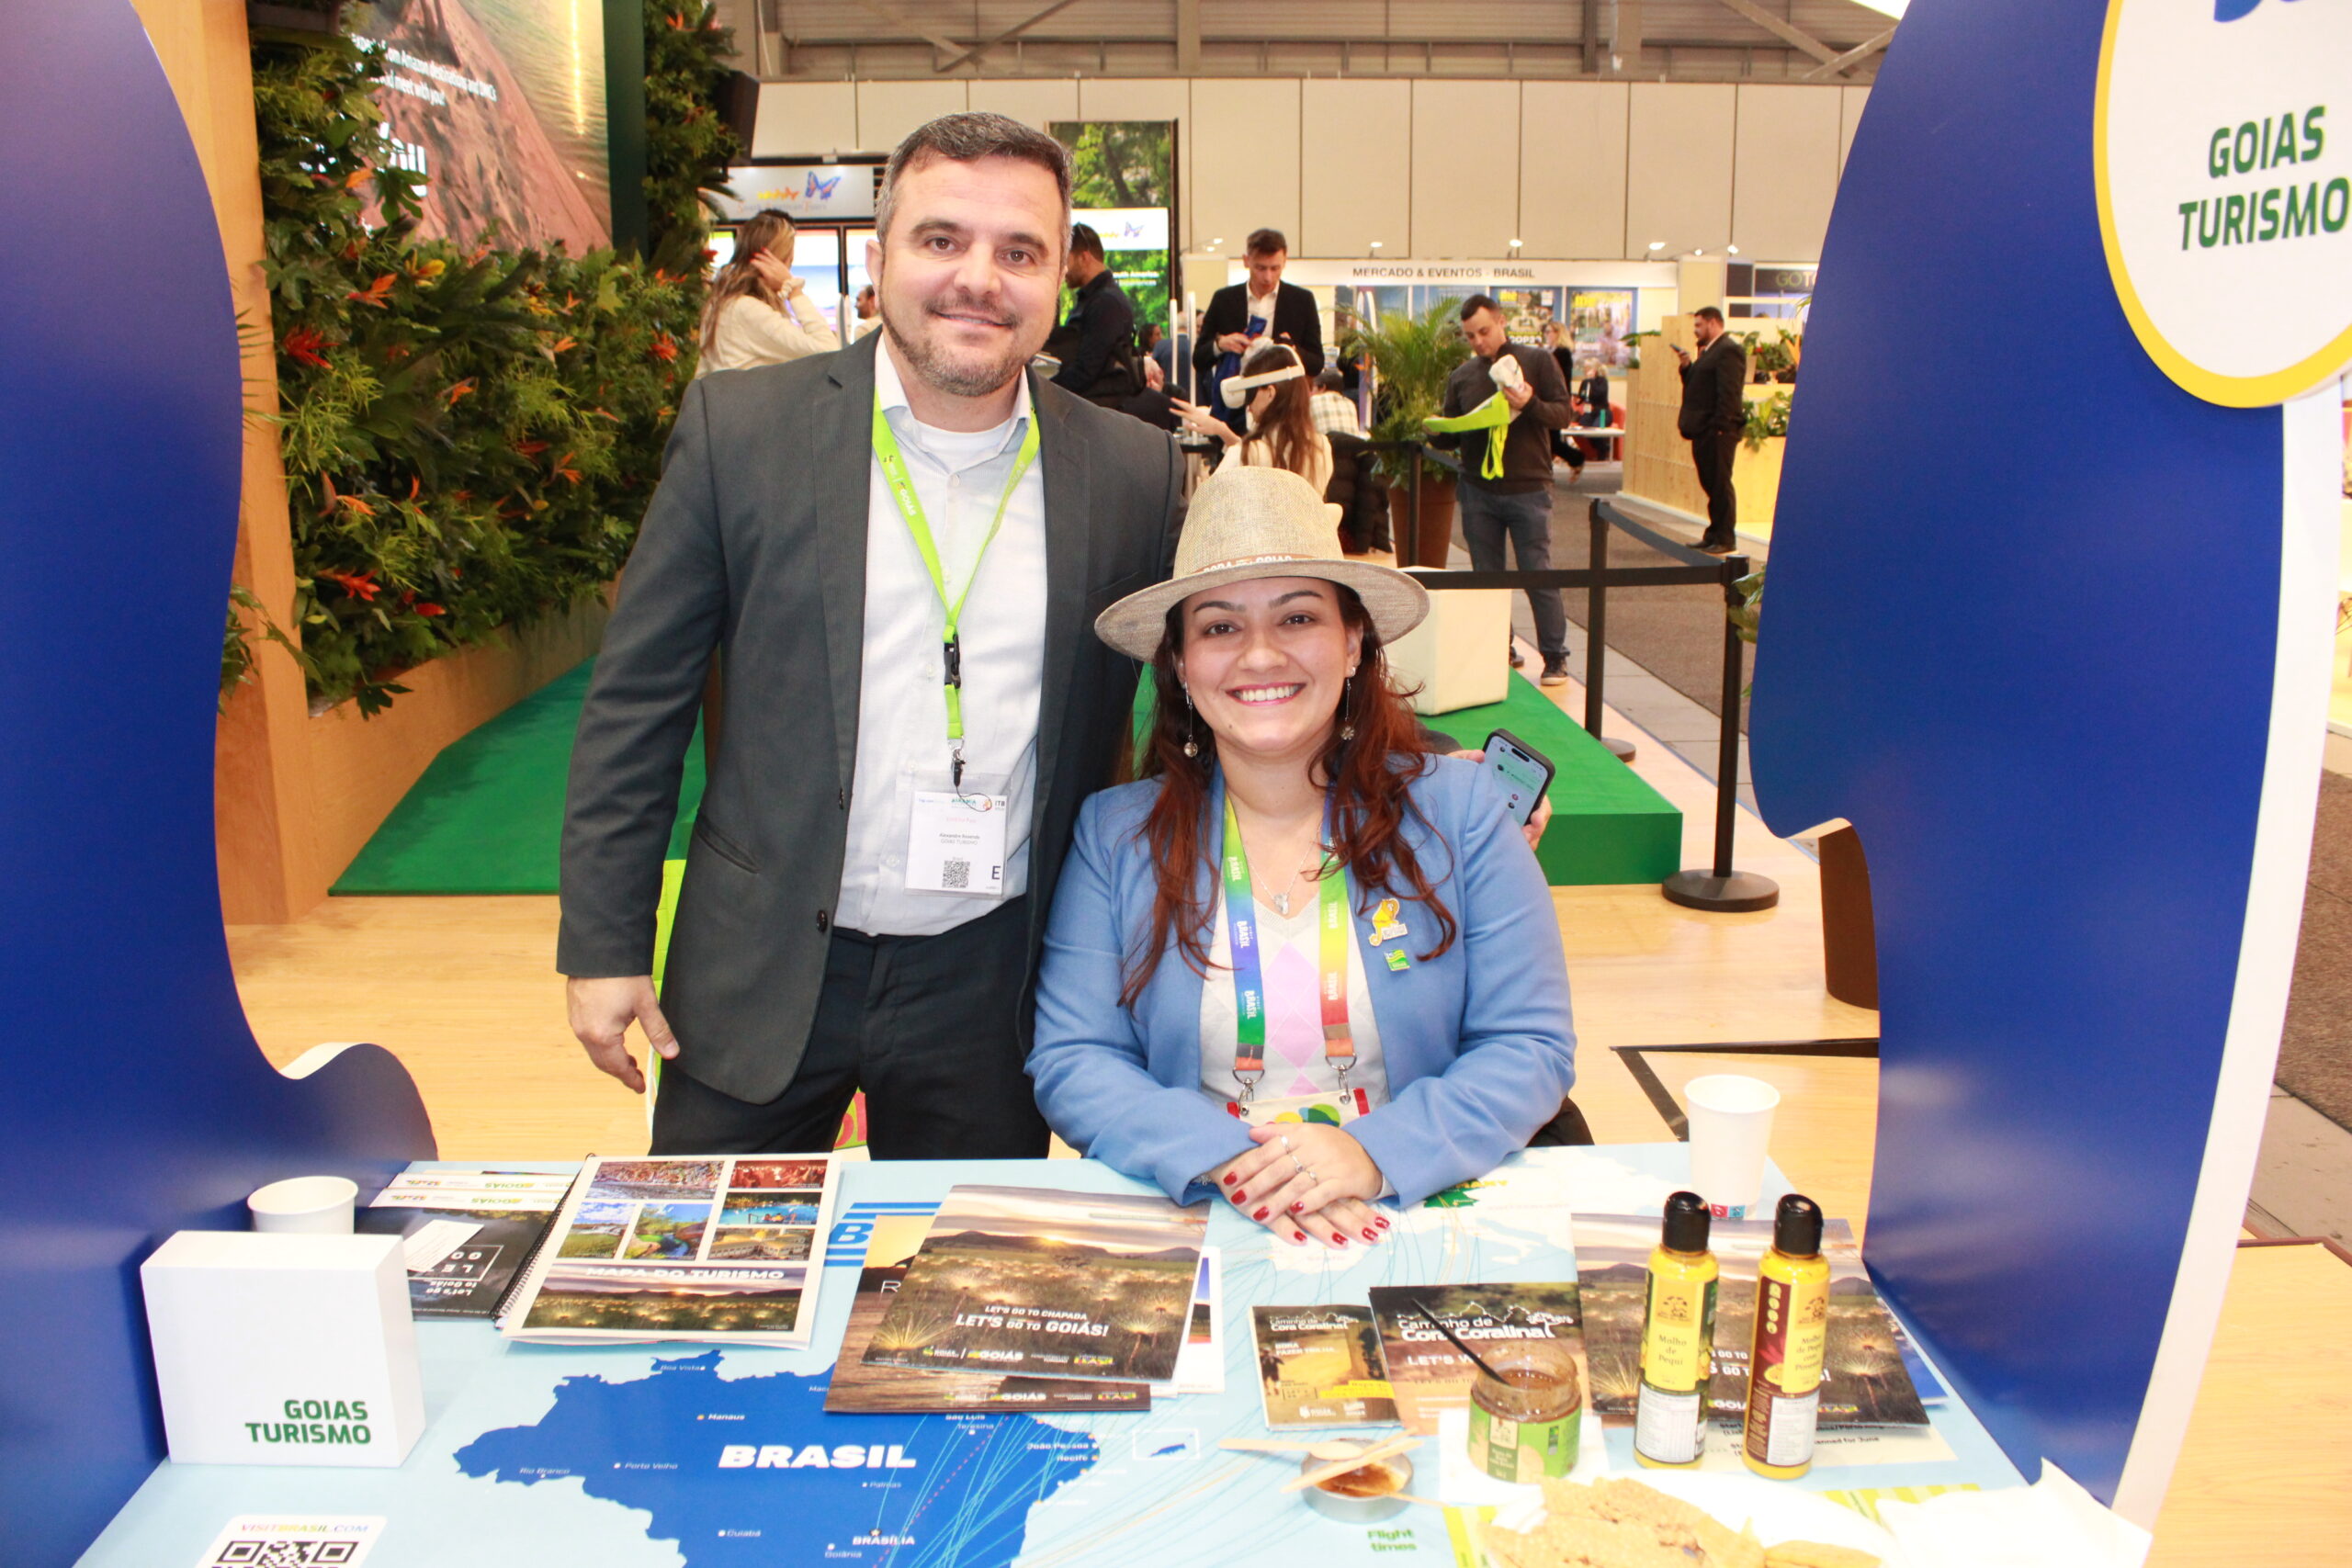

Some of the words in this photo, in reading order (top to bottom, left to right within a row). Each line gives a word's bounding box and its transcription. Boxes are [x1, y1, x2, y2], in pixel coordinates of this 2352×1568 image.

[2209, 106, 2325, 179] GOIAS
[2178, 176, 2350, 251] TURISMO
[1353, 267, 1414, 277] MERCADO
[1417, 268, 1424, 277] &
[1428, 267, 1483, 277] EVENTOS
[1493, 267, 1535, 278] BRASIL
[991, 865, 1001, 880] E
[586, 1268, 648, 1277] MAPA
[652, 1269, 685, 1278] DO
[688, 1269, 786, 1280] TURISMO
[985, 1305, 1011, 1315] LET'S
[1012, 1307, 1026, 1315] GO
[1027, 1308, 1040, 1316] TO
[1041, 1310, 1088, 1320] CHAPADA
[956, 1314, 1004, 1328] LET'S
[1006, 1320, 1023, 1329] GO
[1025, 1322, 1042, 1331] TO
[1046, 1321, 1110, 1337] GOIÁS!
[1397, 1319, 1470, 1330] Camnho
[1473, 1316, 1493, 1327] de
[1454, 1325, 1547, 1340] Coralina
[1658, 1334, 1688, 1347] Molho
[1666, 1346, 1677, 1355] de
[1408, 1355, 1454, 1366] LET'S
[1658, 1354, 1684, 1367] Pequi
[284, 1399, 368, 1421] GOIAS
[244, 1422, 371, 1444] TURISMO
[718, 1445, 917, 1469] BRASIL
[241, 1524, 369, 1533] VISITBRASIL.COM
[1367, 1529, 1415, 1540] Flight
[852, 1535, 915, 1546] BRASÍLIA
[1371, 1542, 1418, 1552] times
